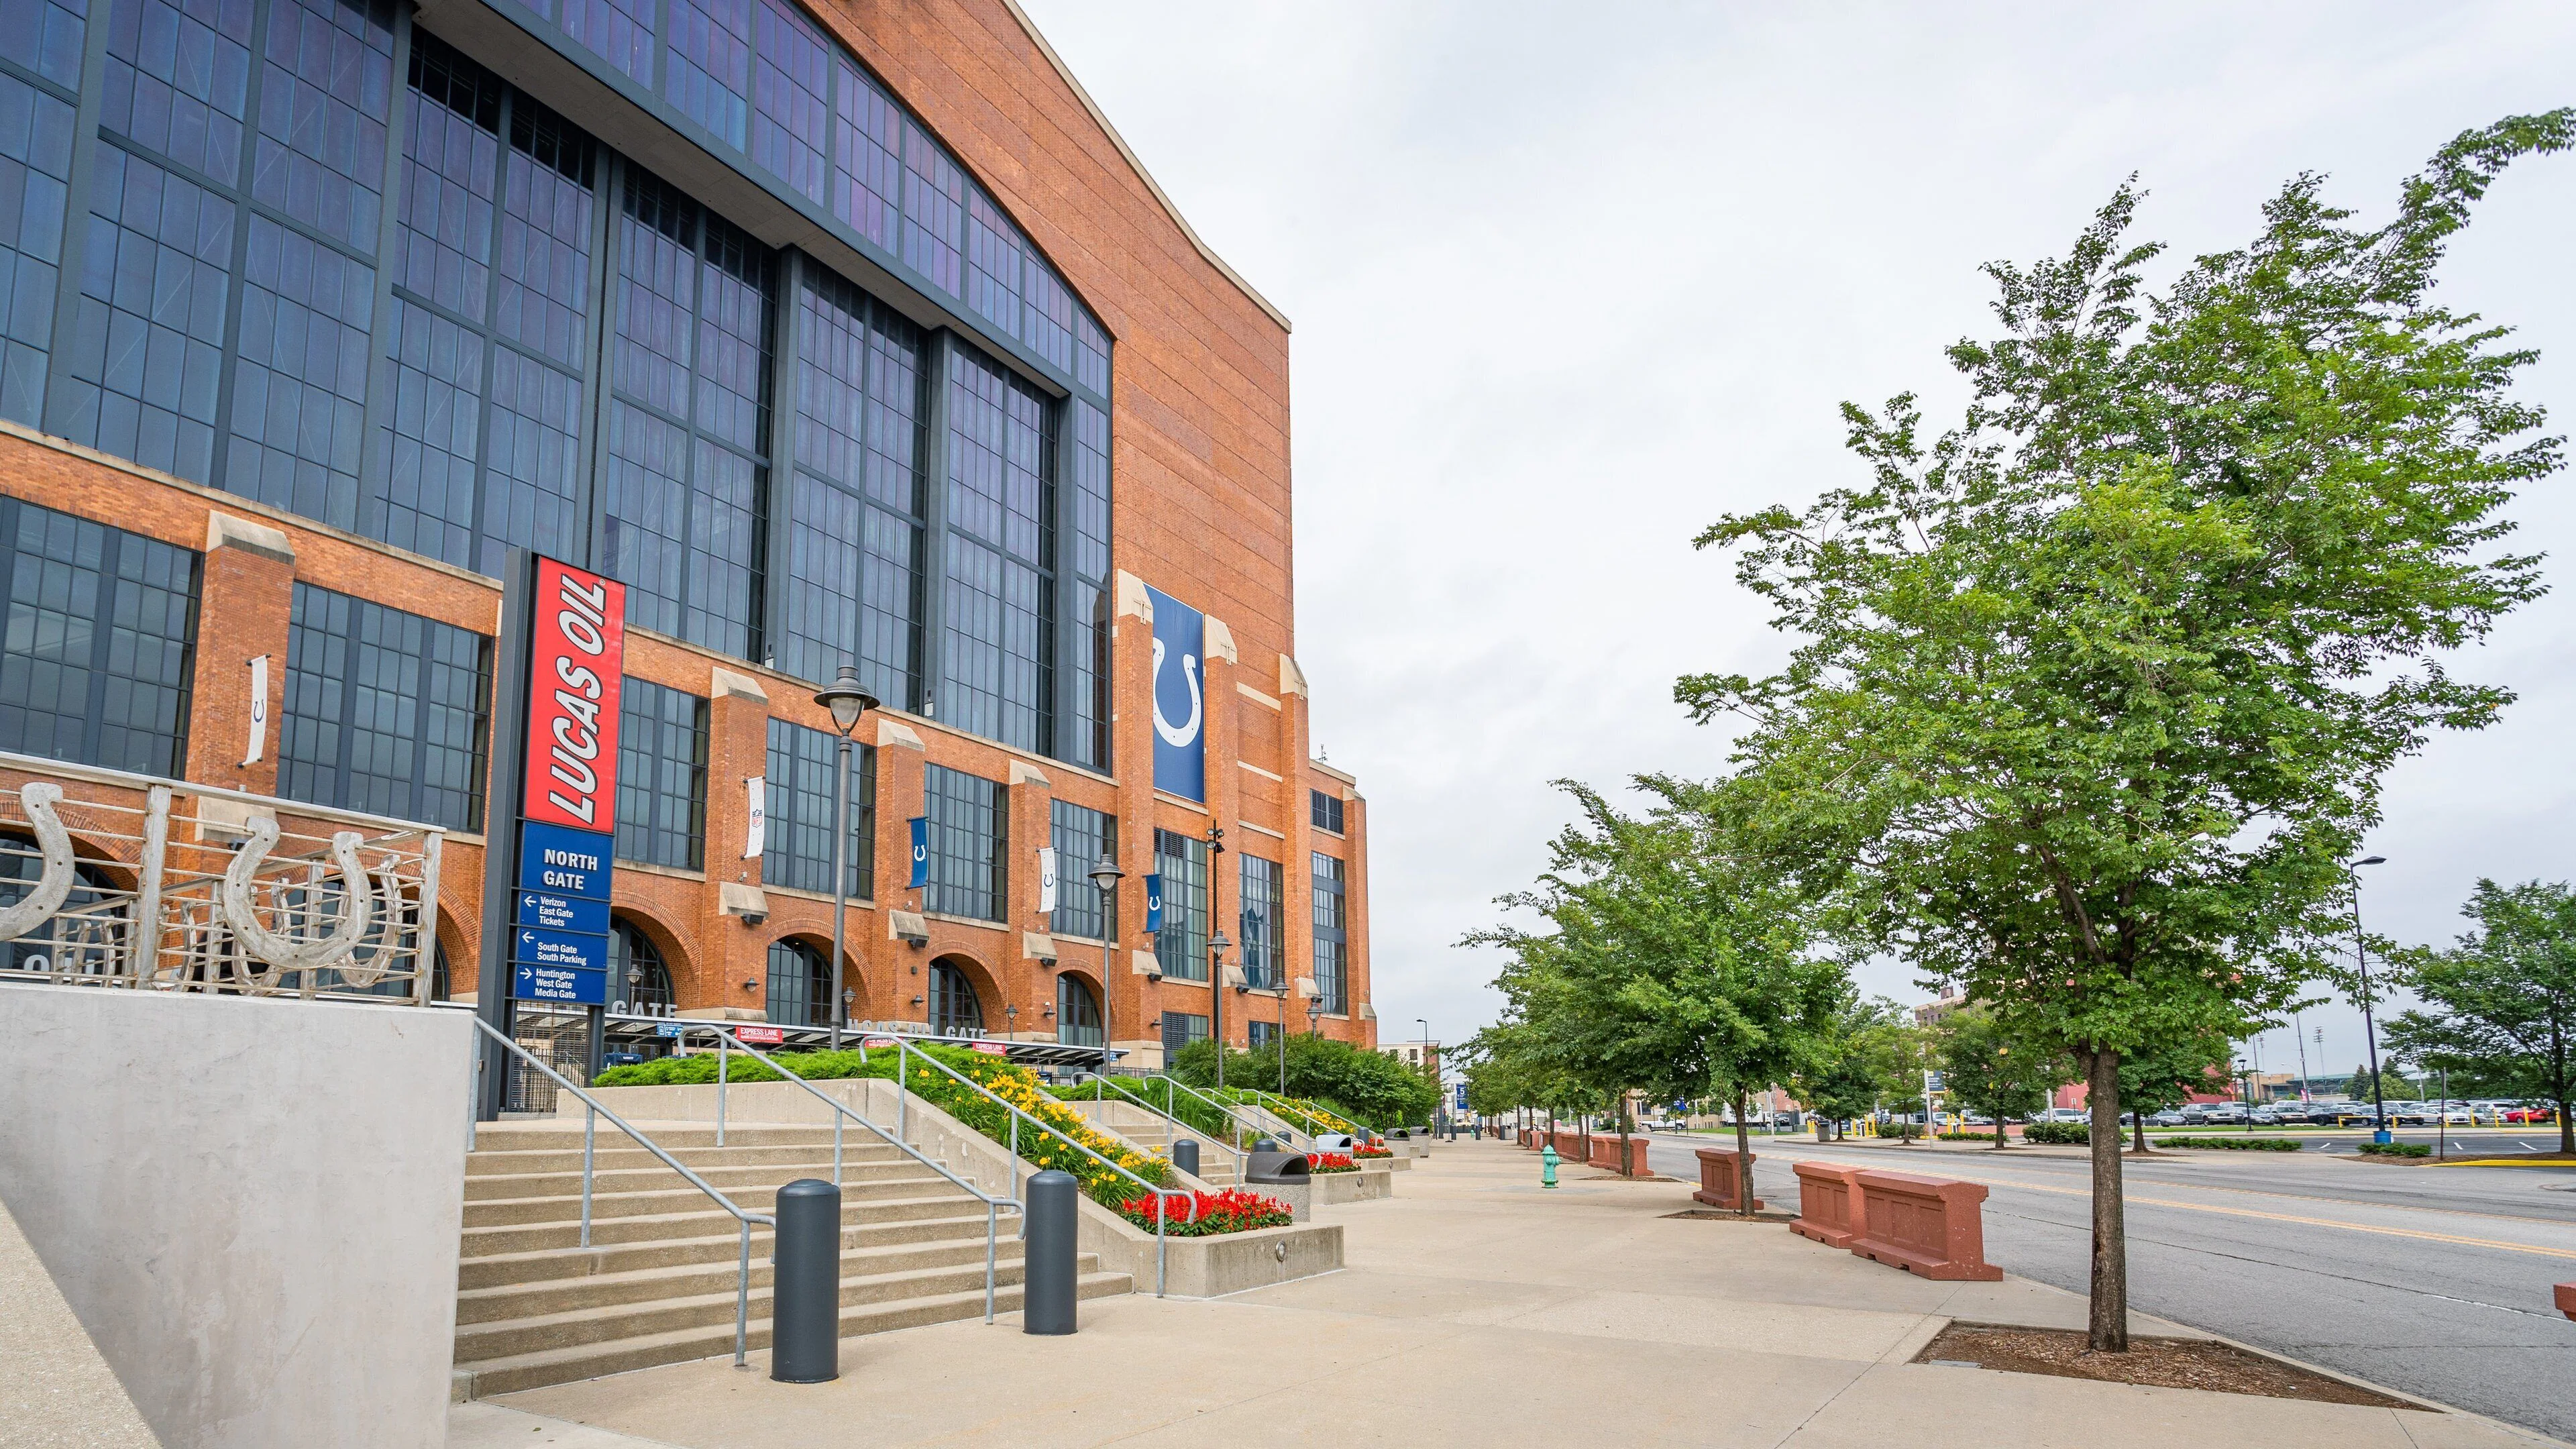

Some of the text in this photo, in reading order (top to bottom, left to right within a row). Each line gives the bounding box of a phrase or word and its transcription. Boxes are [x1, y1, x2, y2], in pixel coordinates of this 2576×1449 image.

[549, 655, 604, 825] LUCAS
[544, 849, 598, 871] NORTH
[542, 870, 585, 890] GATE
[540, 896, 566, 908] Verizon
[539, 906, 574, 918] East Gate
[539, 915, 565, 926] Tickets
[537, 942, 578, 954] South Gate
[537, 951, 587, 966] South Parking
[535, 968, 576, 980] Huntington
[536, 977, 572, 989] West Gate
[535, 987, 576, 999] Media Gate
[611, 1000, 678, 1018] GATE
[740, 1027, 764, 1036] EXPRESS
[945, 1026, 987, 1040] GATE
